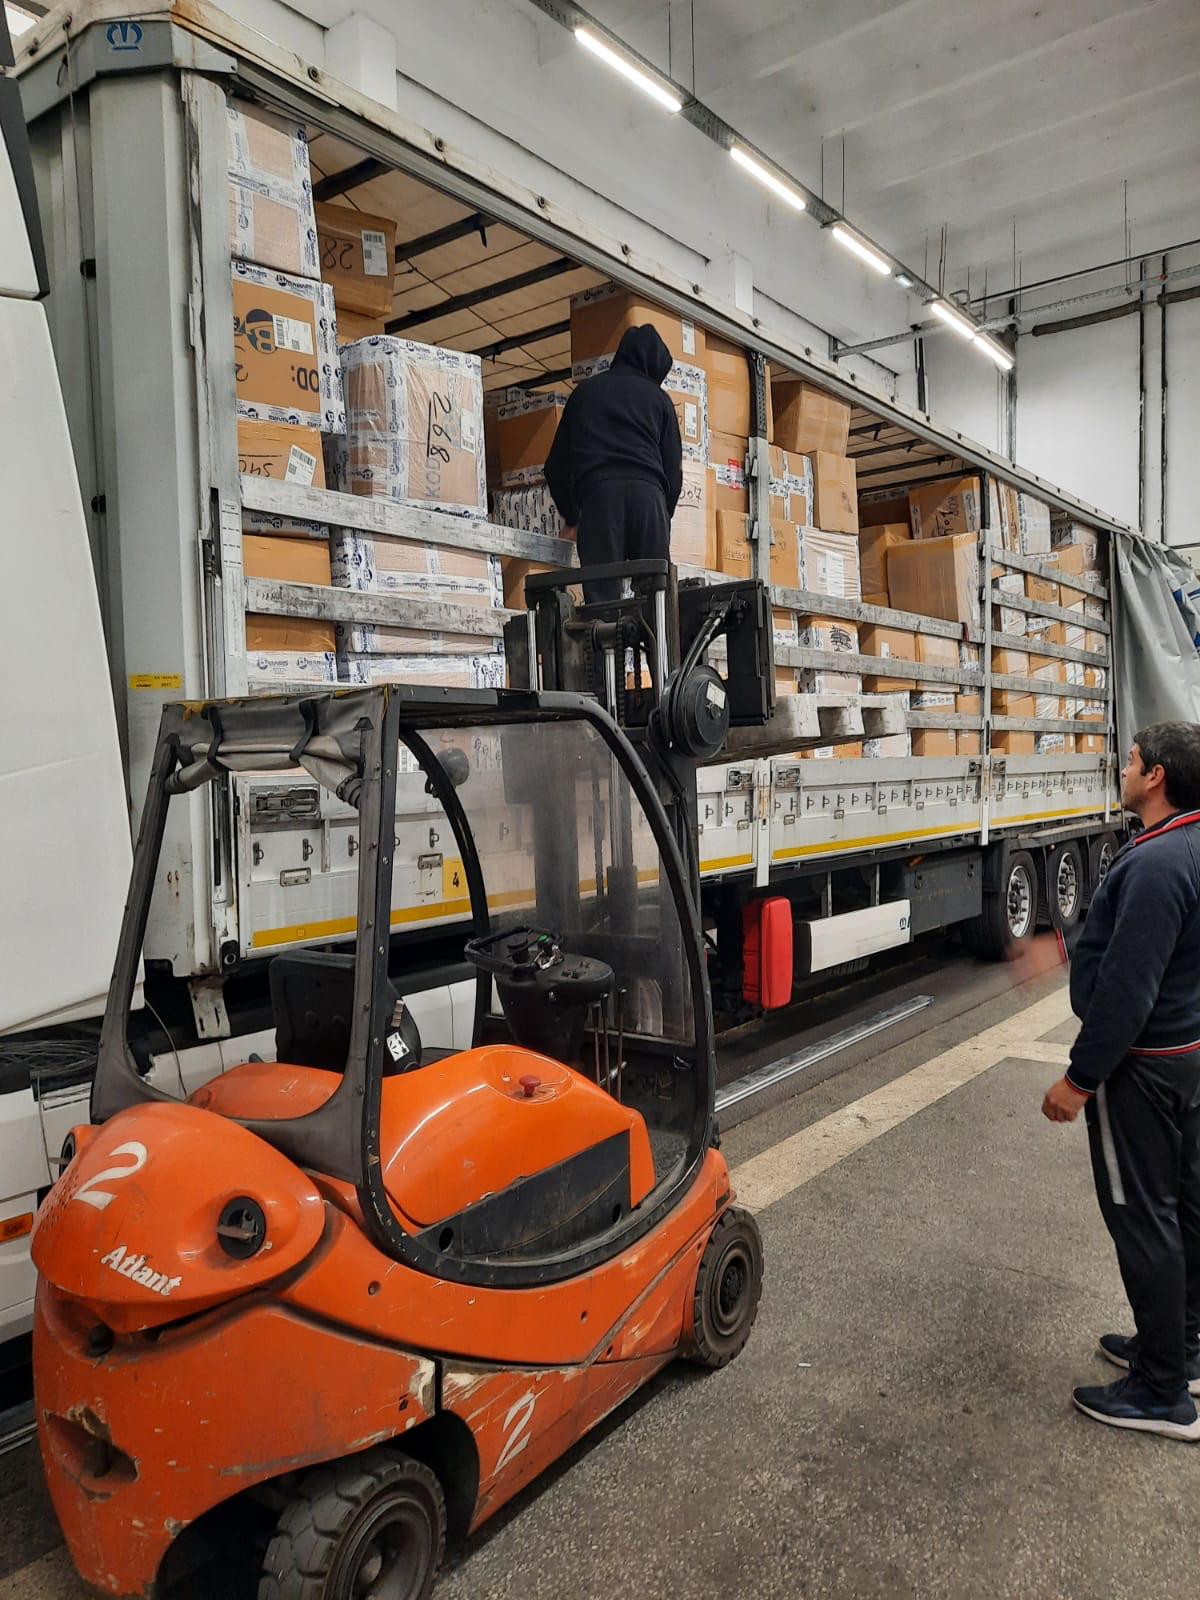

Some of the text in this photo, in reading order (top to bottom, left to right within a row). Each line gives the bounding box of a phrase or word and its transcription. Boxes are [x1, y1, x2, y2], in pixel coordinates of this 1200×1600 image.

[291, 365, 319, 393] OD:
[452, 871, 460, 888] 4
[72, 1140, 148, 1211] 2
[101, 1245, 181, 1296] Atlant
[493, 1391, 535, 1477] 2
